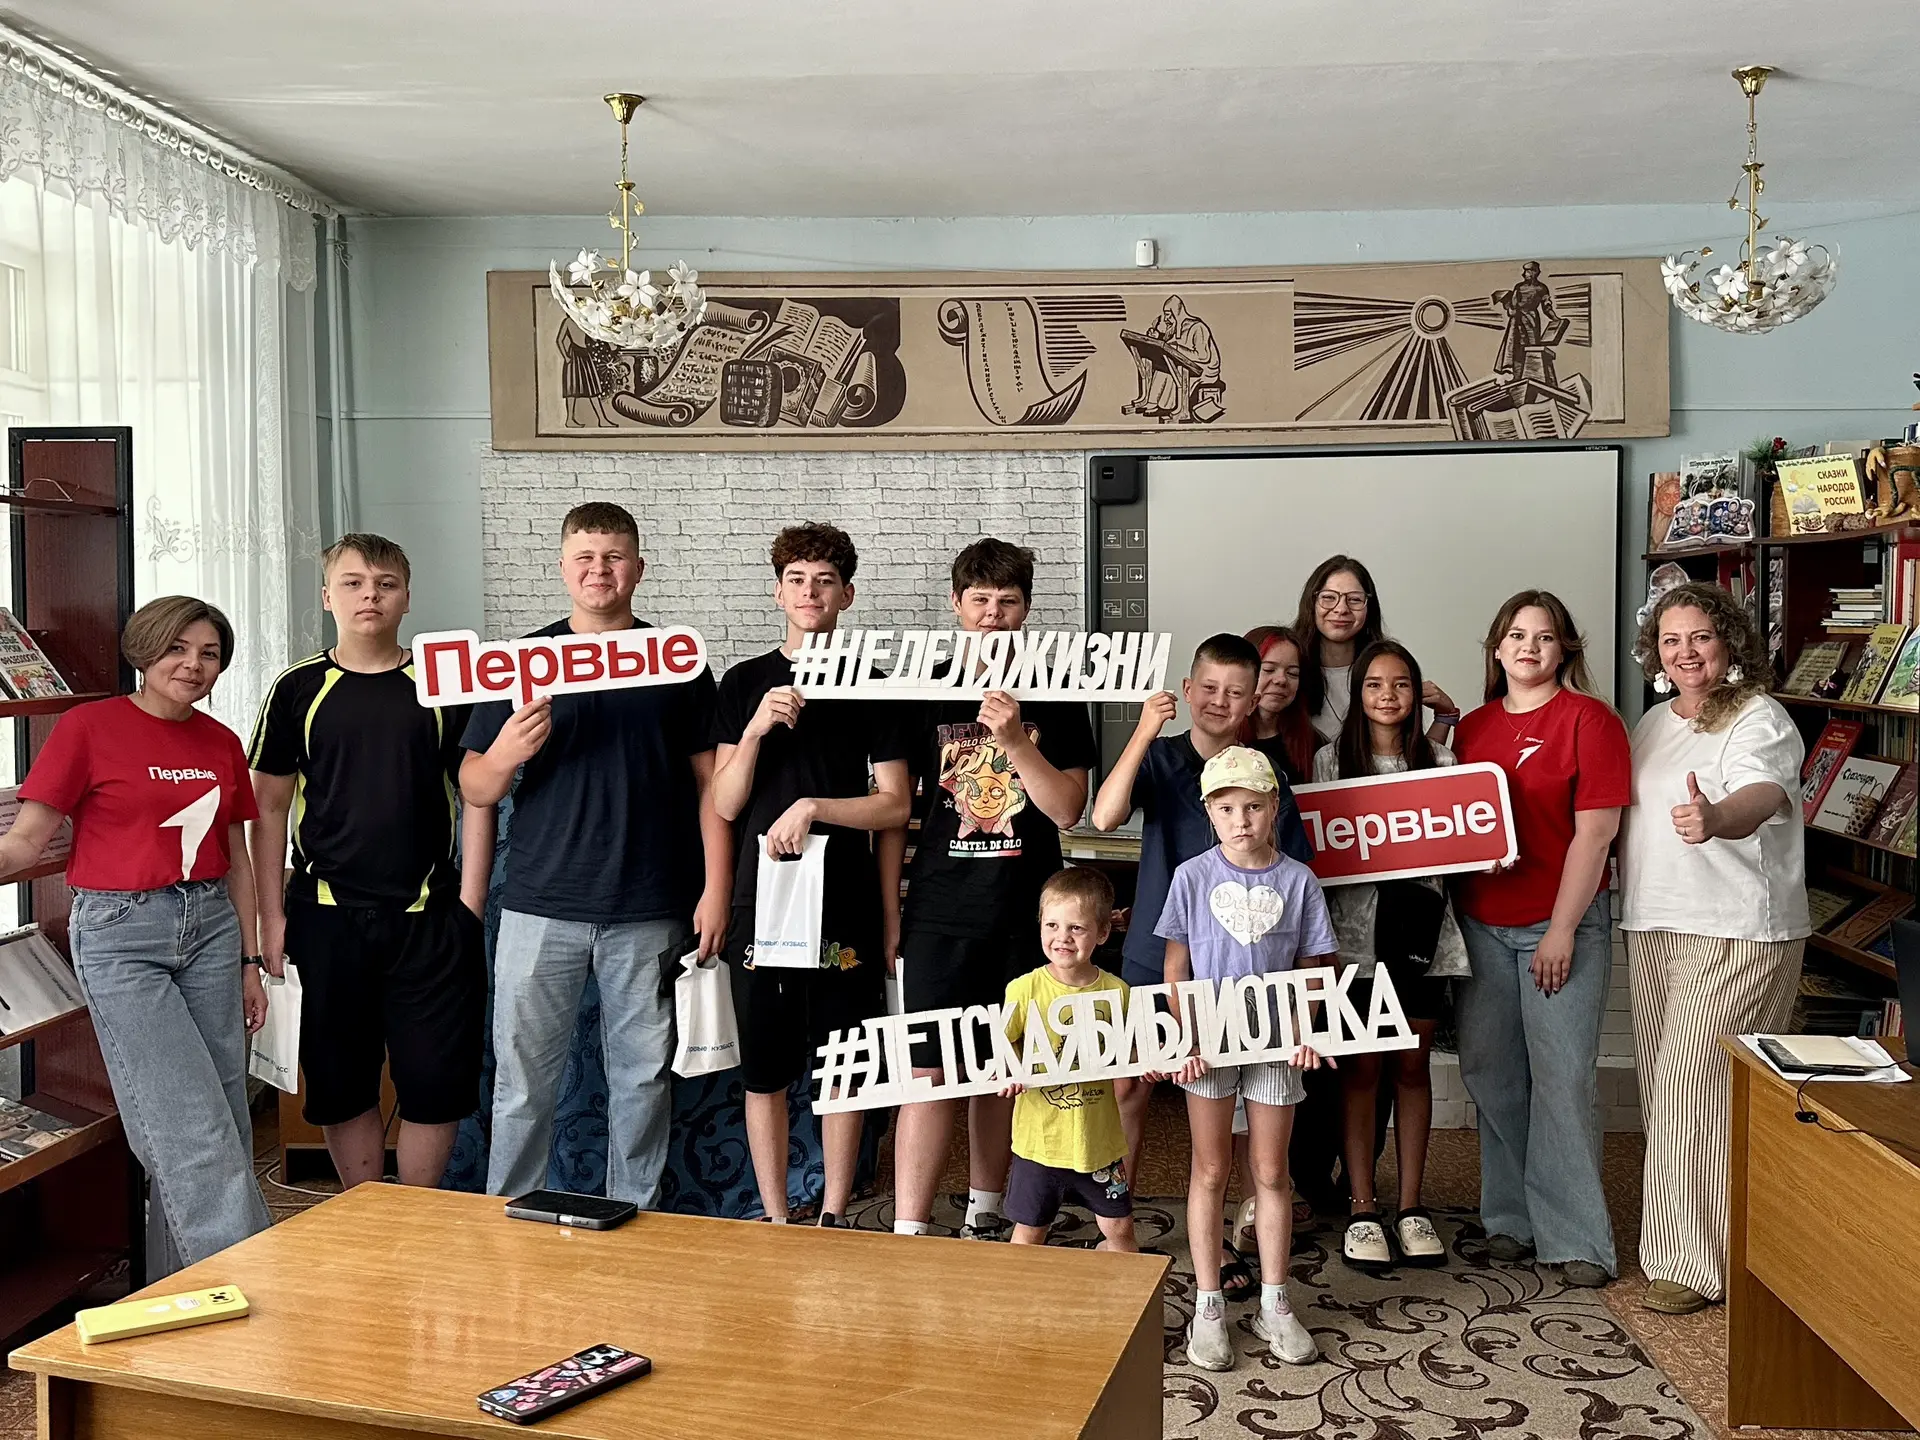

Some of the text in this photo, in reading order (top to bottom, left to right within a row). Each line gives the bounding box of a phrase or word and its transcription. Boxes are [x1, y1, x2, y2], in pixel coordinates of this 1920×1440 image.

[1817, 469, 1848, 480] СКАЗКИ
[1816, 482, 1855, 494] НАРОДОВ
[1824, 496, 1856, 506] РОССИИ
[790, 629, 1172, 692] #НЕДЕЛЯЖИЗНИ
[423, 634, 699, 705] Первые
[960, 738, 978, 748] GLO
[147, 766, 218, 785] Первые
[949, 838, 1022, 851] CARTEL DE GLO
[811, 961, 1409, 1103] #ДЕТСКАЯБИБЛИОТЕКА
